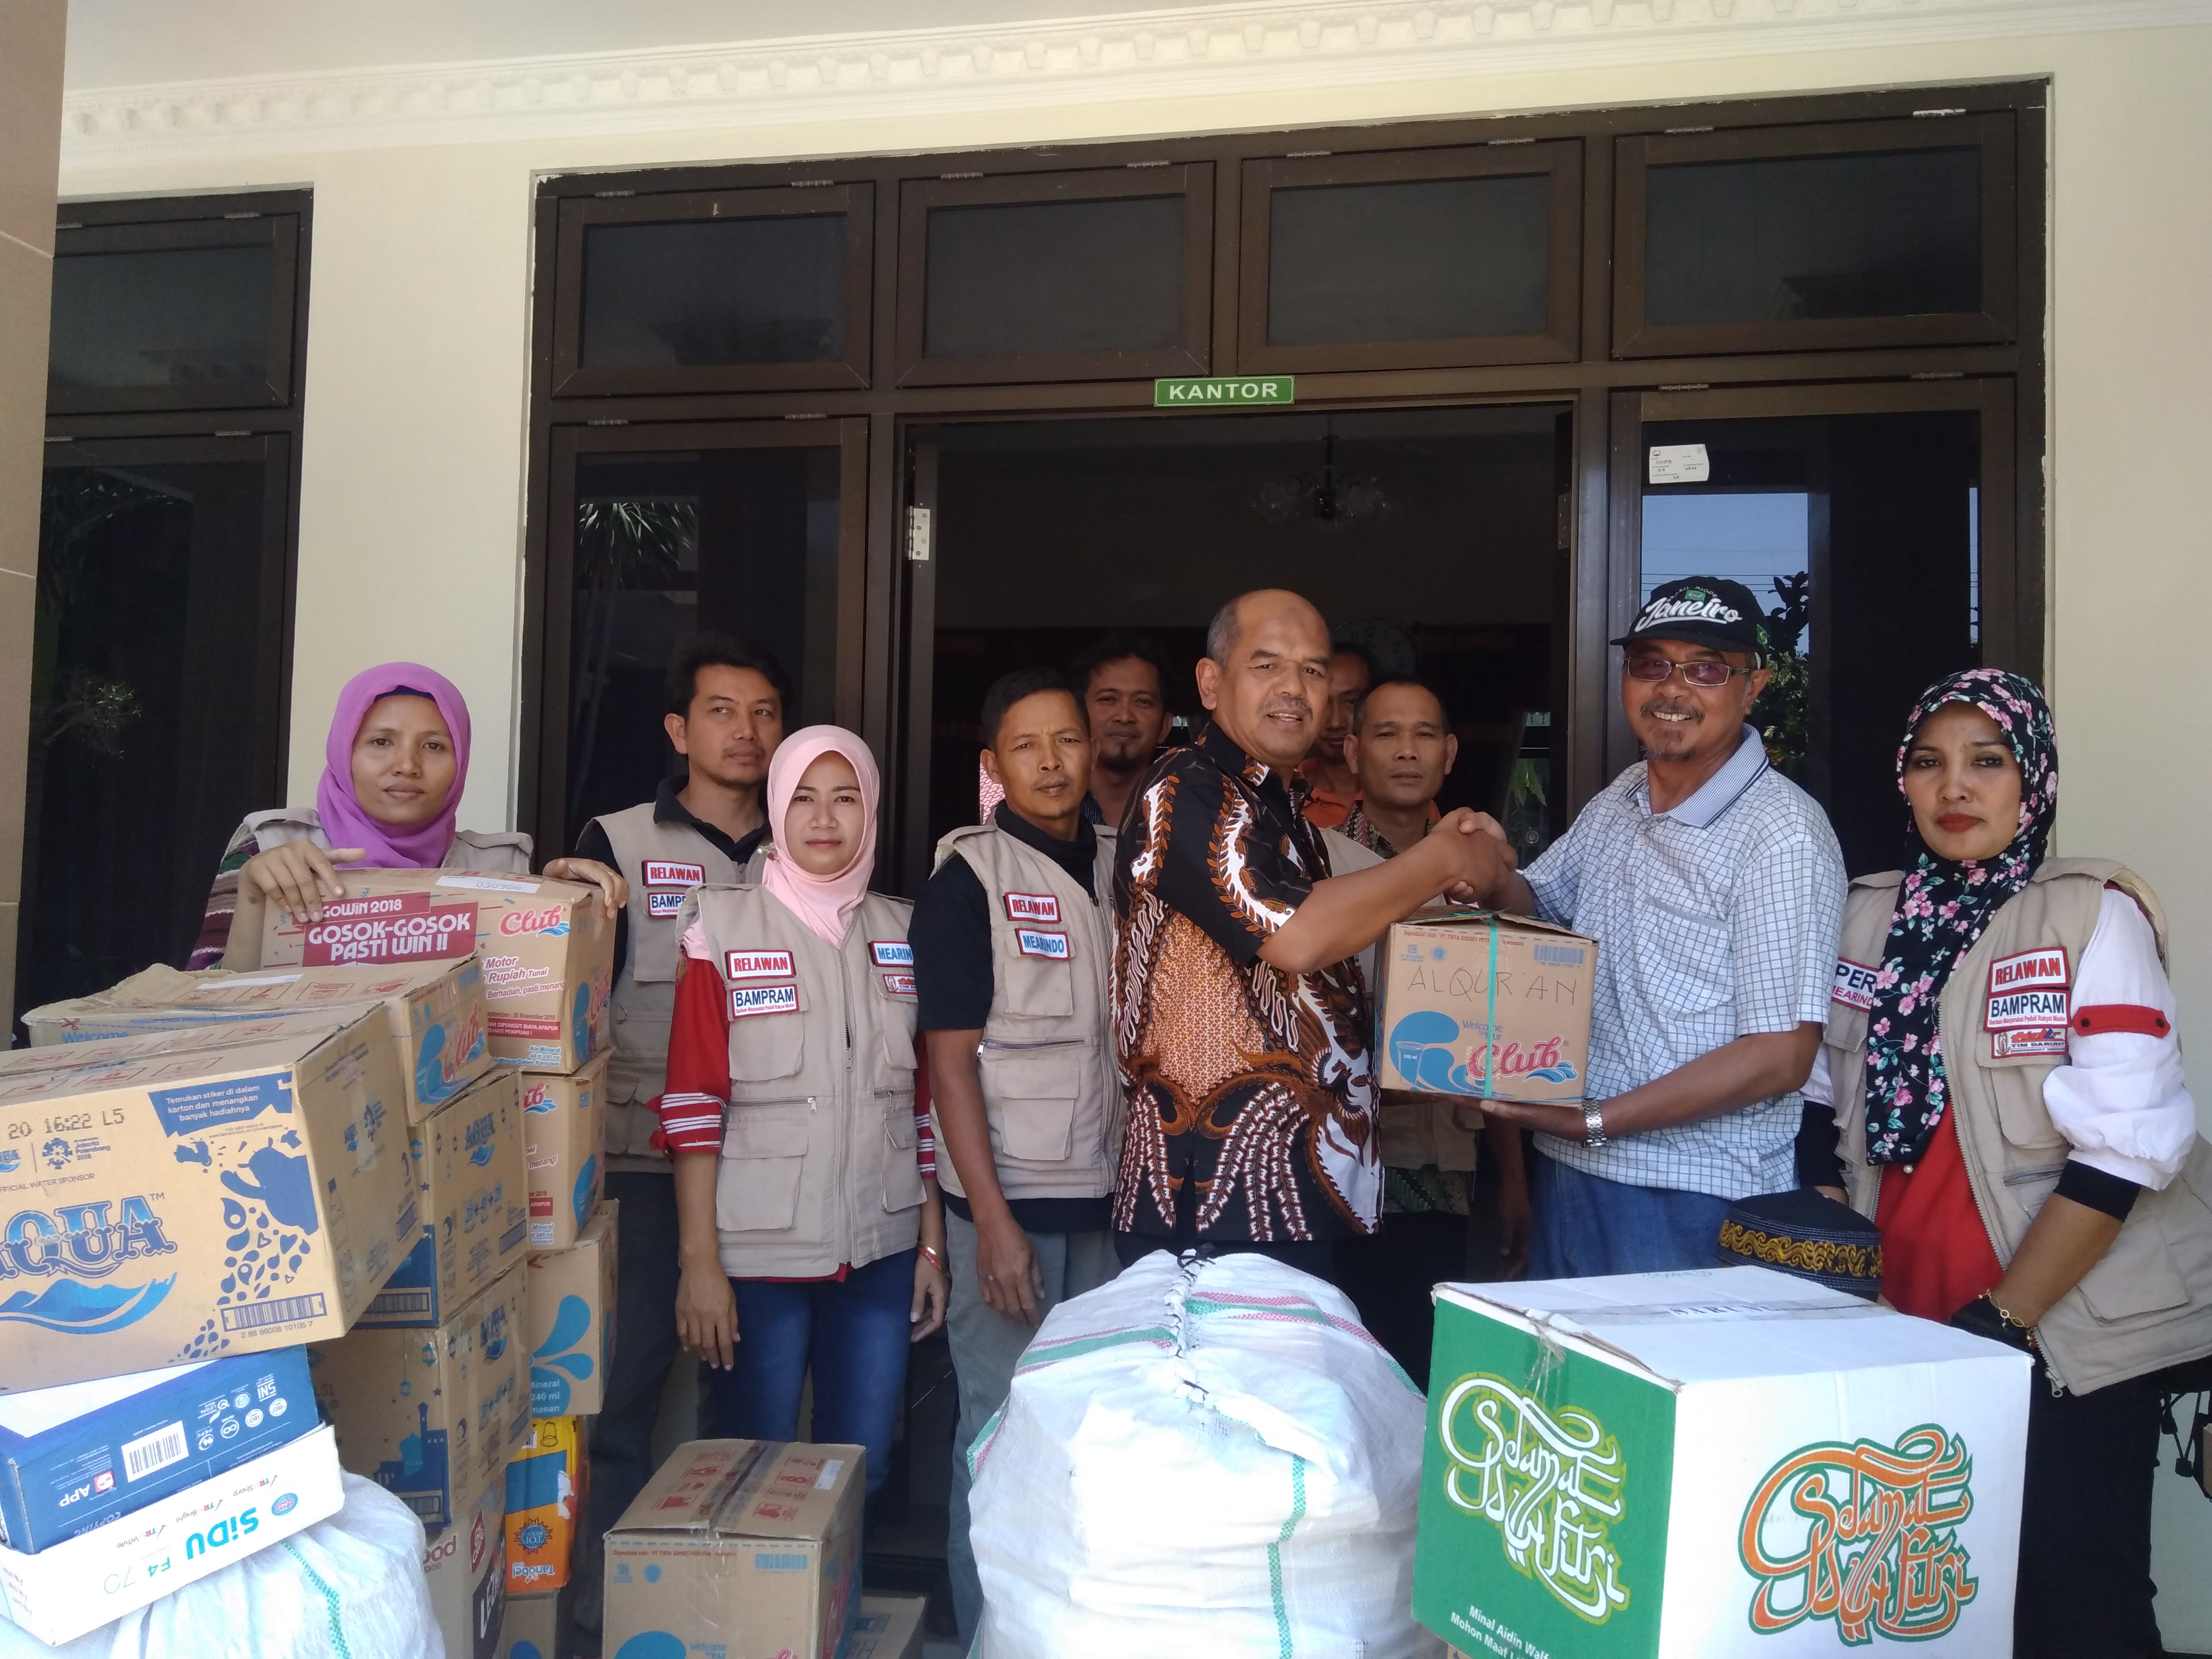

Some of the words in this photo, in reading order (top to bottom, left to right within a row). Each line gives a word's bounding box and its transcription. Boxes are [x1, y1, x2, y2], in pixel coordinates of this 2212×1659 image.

[1170, 383, 1278, 399] KANTOR
[1635, 597, 1743, 633] Janeiro
[1364, 626, 1376, 638] 12
[650, 867, 700, 881] RELAWAN
[371, 899, 403, 914] 2018
[1012, 899, 1055, 916] RELAWAN
[308, 912, 471, 945] GOSOK-GOSOK
[499, 904, 563, 936] Club
[331, 939, 387, 961] PASTI
[392, 936, 432, 956] WIN
[435, 933, 448, 952] !!
[1023, 935, 1064, 953] MEARINDO
[877, 948, 912, 960] MEARIN
[485, 957, 517, 970] Motor
[734, 957, 788, 972] RELAWAN
[1995, 958, 2061, 985] RELAWAN
[489, 969, 525, 983] Rupiah
[1834, 963, 1878, 993] PER
[488, 987, 522, 999] Berhadiah,
[523, 983, 539, 995] pasti
[735, 988, 794, 1007] BAMPRAM
[1991, 994, 2065, 1018] BAMPRAM
[1484, 1031, 1502, 1041] Yur
[1467, 1034, 1563, 1079] Club
[166, 1093, 202, 1104] Temukan
[203, 1091, 225, 1099] stiker
[235, 1085, 259, 1094] dalam
[167, 1103, 195, 1113] karton
[195, 1101, 210, 1110] dan
[212, 1094, 258, 1107] menangkan
[179, 1111, 208, 1121] banyak
[210, 1104, 250, 1117] hadiahnya
[8, 1121, 33, 1139] 20
[45, 1113, 93, 1134] 16:22
[102, 1108, 125, 1126] L5
[76, 1144, 111, 1154] Palembang
[29, 1178, 58, 1188] WATER
[58, 1173, 95, 1184] SPONSOR
[0, 1195, 179, 1279] QUA
[285, 1322, 306, 1331] 10105
[257, 1382, 276, 1399] SNI
[531, 1393, 547, 1401] 240
[199, 1404, 216, 1414] LEGAL
[249, 1415, 260, 1423] ISO
[196, 1428, 213, 1438] PEFC
[59, 1484, 90, 1507] APP
[186, 1506, 259, 1561] SiDU
[147, 1556, 172, 1578] F4
[513, 1565, 554, 1577] Tanobel
[104, 1566, 136, 1594] 70
[1451, 1611, 1482, 1641] Mohon
[1484, 1633, 1509, 1659] Maaf
[1469, 1605, 1496, 1631] Minal
[1497, 1624, 1522, 1649] Aidin
